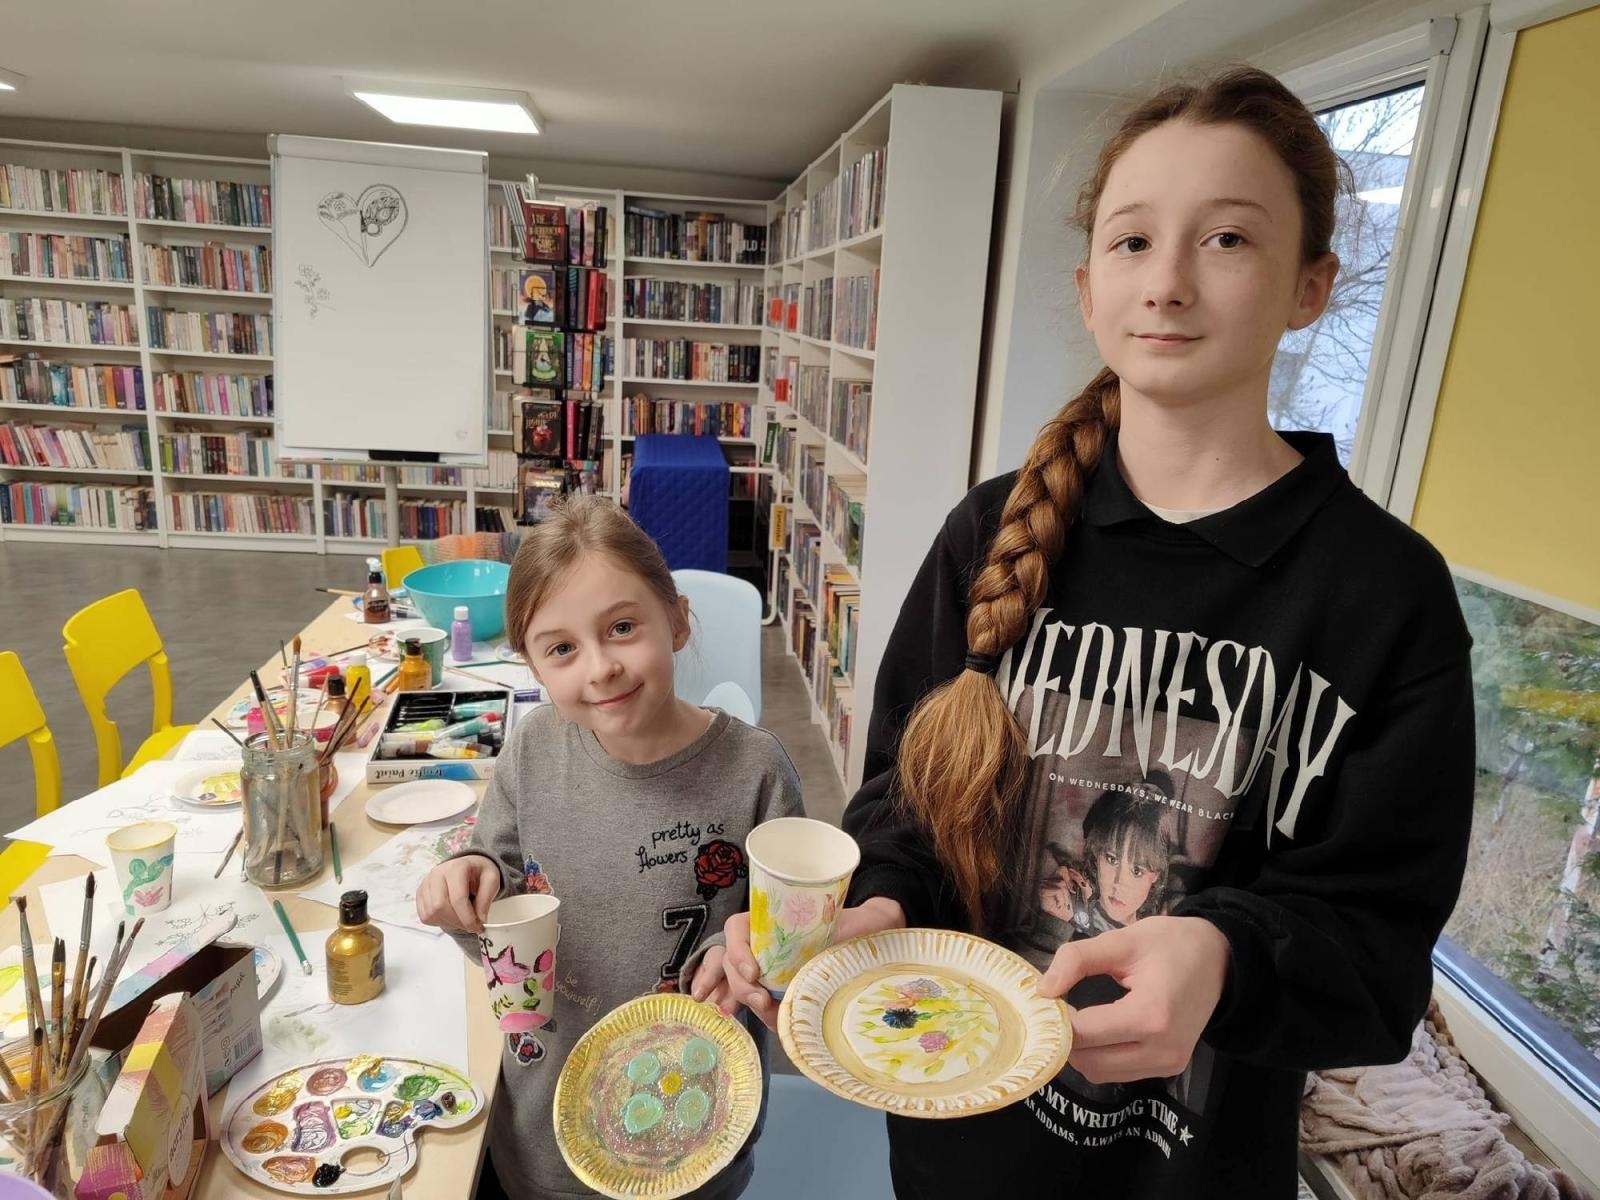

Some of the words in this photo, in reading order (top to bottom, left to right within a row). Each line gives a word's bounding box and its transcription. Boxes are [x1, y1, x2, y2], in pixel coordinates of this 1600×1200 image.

[375, 768, 405, 780] Paint
[1049, 773, 1065, 784] ON
[1069, 777, 1150, 800] WEDNESDAYS,
[1154, 794, 1168, 805] WE
[1169, 799, 1193, 815] WEAR
[652, 820, 701, 846] pretty
[706, 822, 725, 835] as
[635, 845, 688, 874] flowers
[662, 904, 710, 979] 7
[1035, 1106, 1079, 1146] ADDAMS,
[1125, 1127, 1141, 1137] AN
[1045, 1084, 1070, 1116] MY
[1071, 1098, 1144, 1128] WRITING
[1147, 1098, 1178, 1136] TIME
